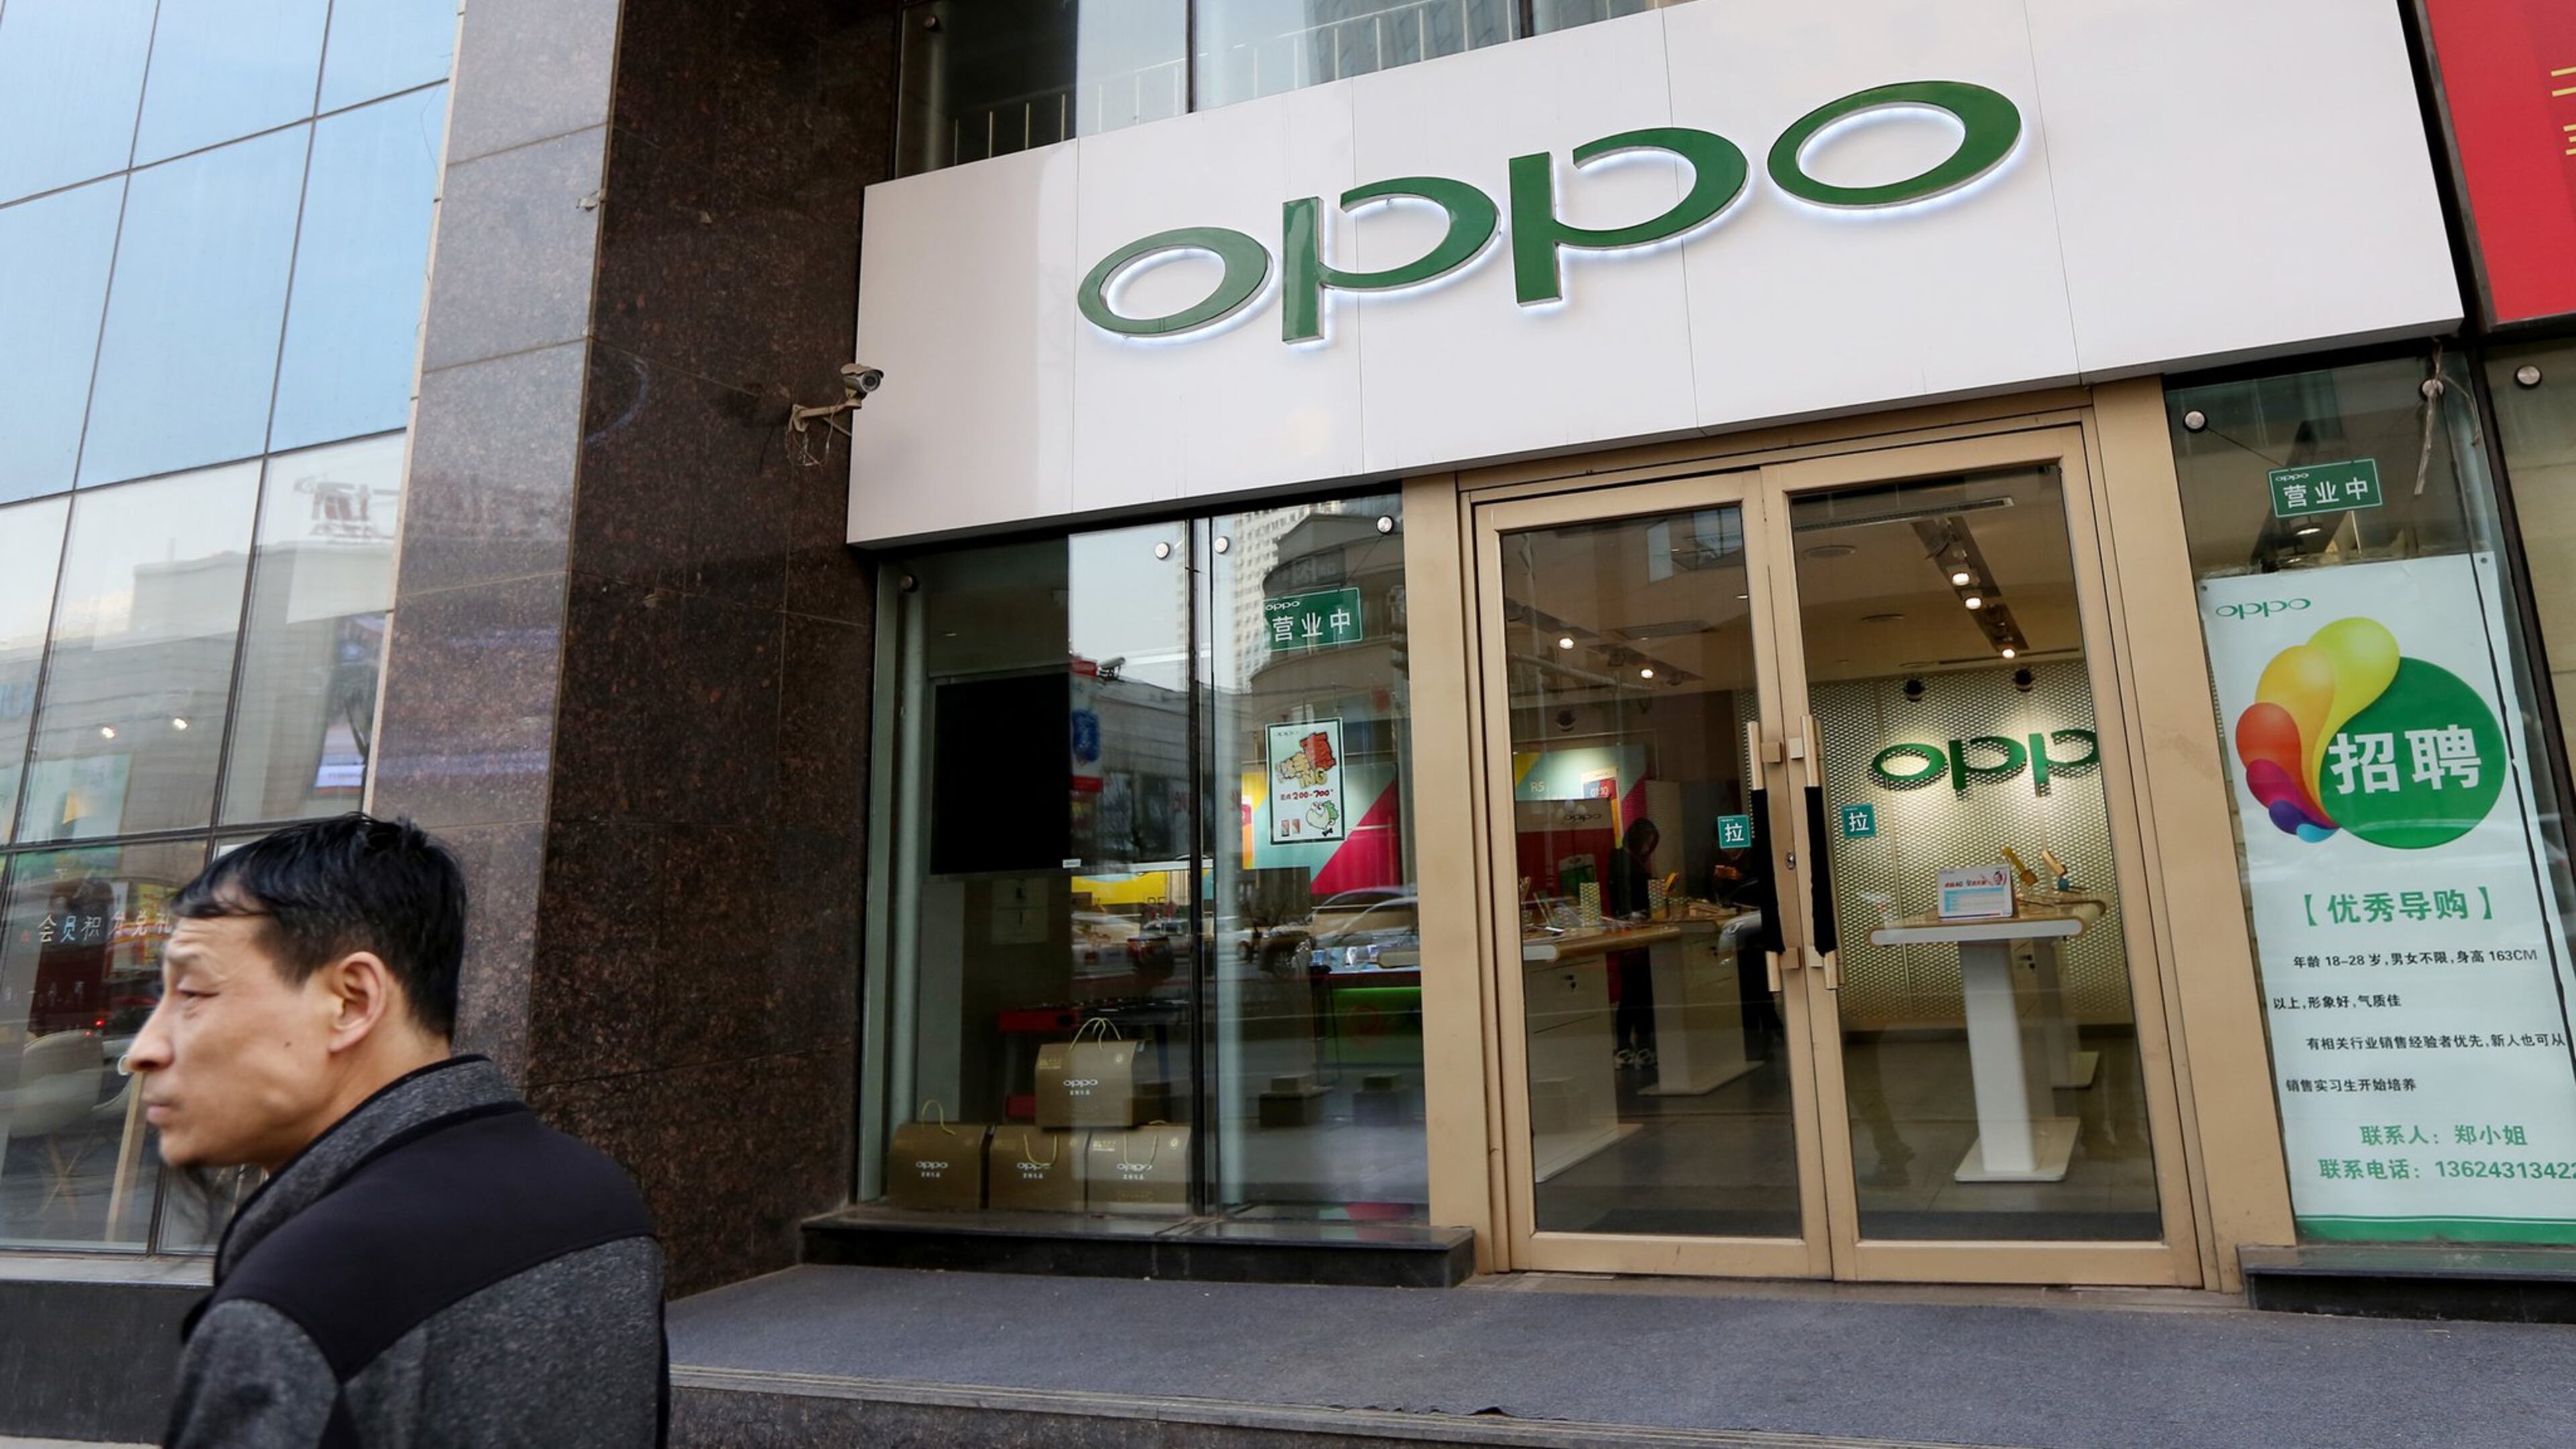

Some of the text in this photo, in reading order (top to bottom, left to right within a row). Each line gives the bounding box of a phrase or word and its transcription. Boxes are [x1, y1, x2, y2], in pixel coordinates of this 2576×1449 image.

[2284, 477, 2369, 508] 营业中
[1273, 608, 1350, 642] 营业中
[2329, 724, 2481, 794] 招聘
[1725, 823, 1744, 842] 拉
[1849, 812, 1869, 832] 拉
[2286, 1079, 2416, 1093] 销售实习生开始培养
